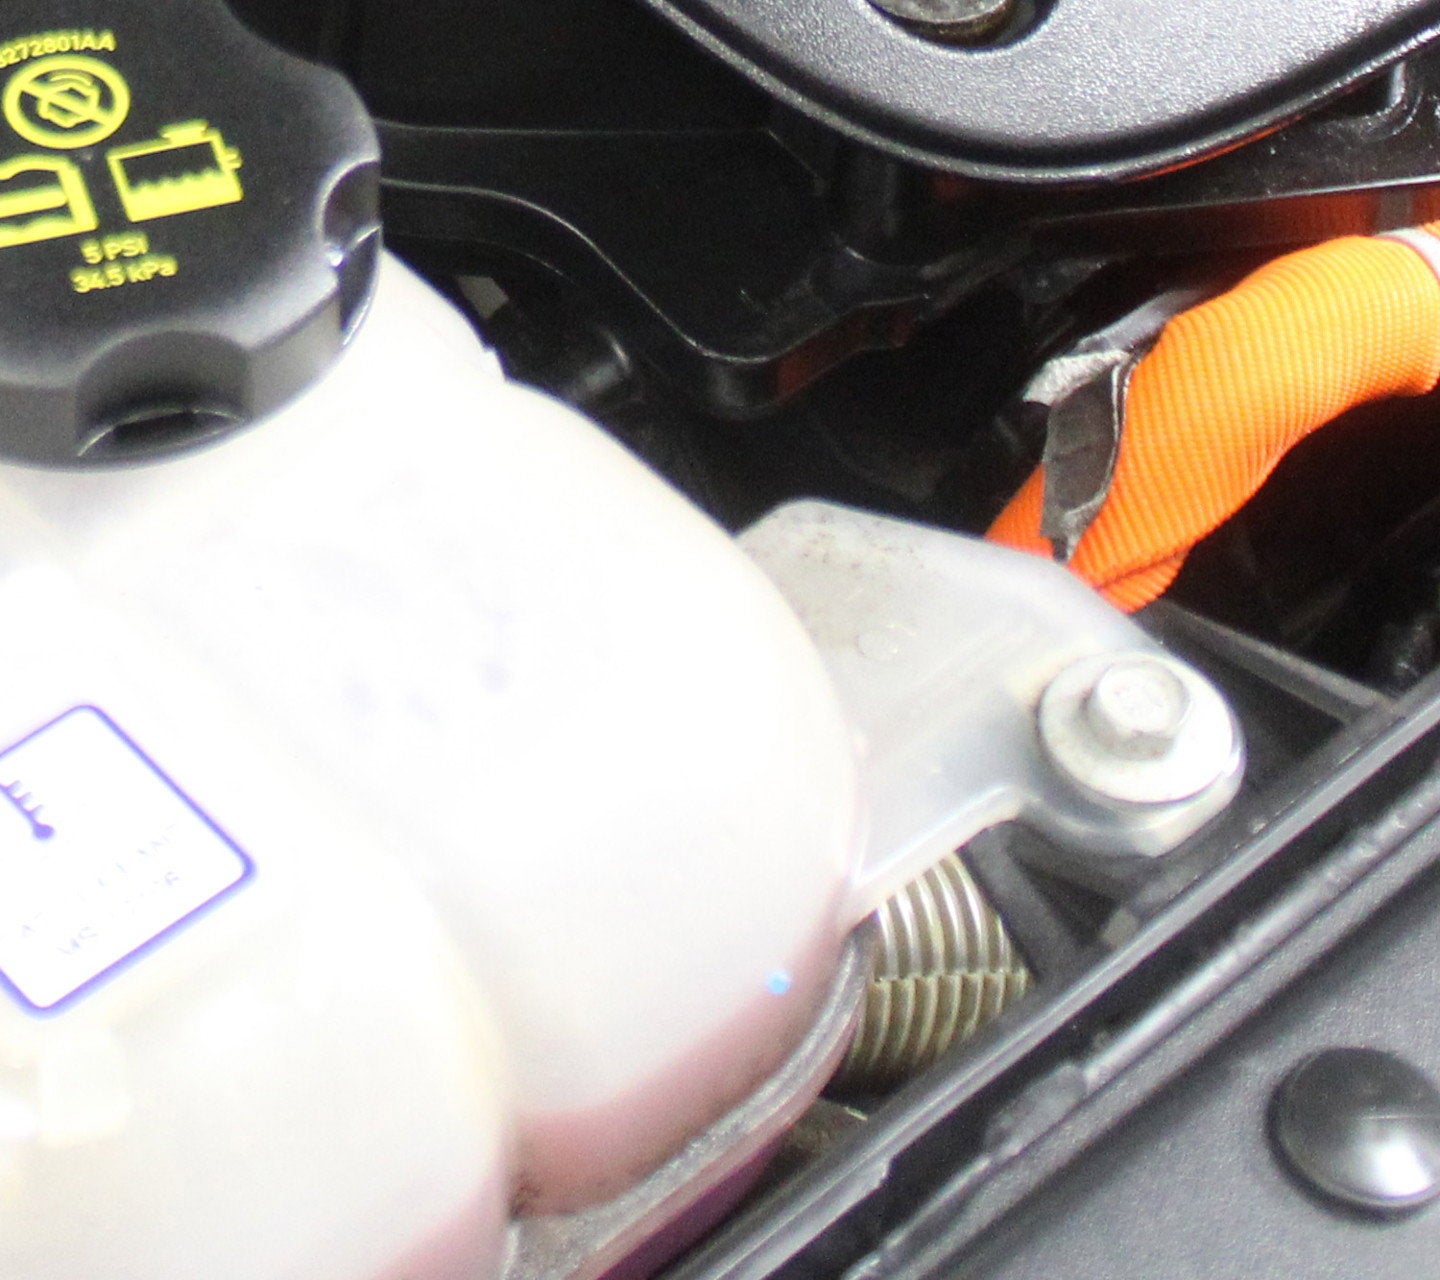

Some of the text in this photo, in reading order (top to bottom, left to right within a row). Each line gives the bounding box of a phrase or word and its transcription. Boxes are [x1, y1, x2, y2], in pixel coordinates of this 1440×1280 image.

[80, 230, 150, 266] 5 PSI
[70, 254, 179, 294] 34.5 kPa
